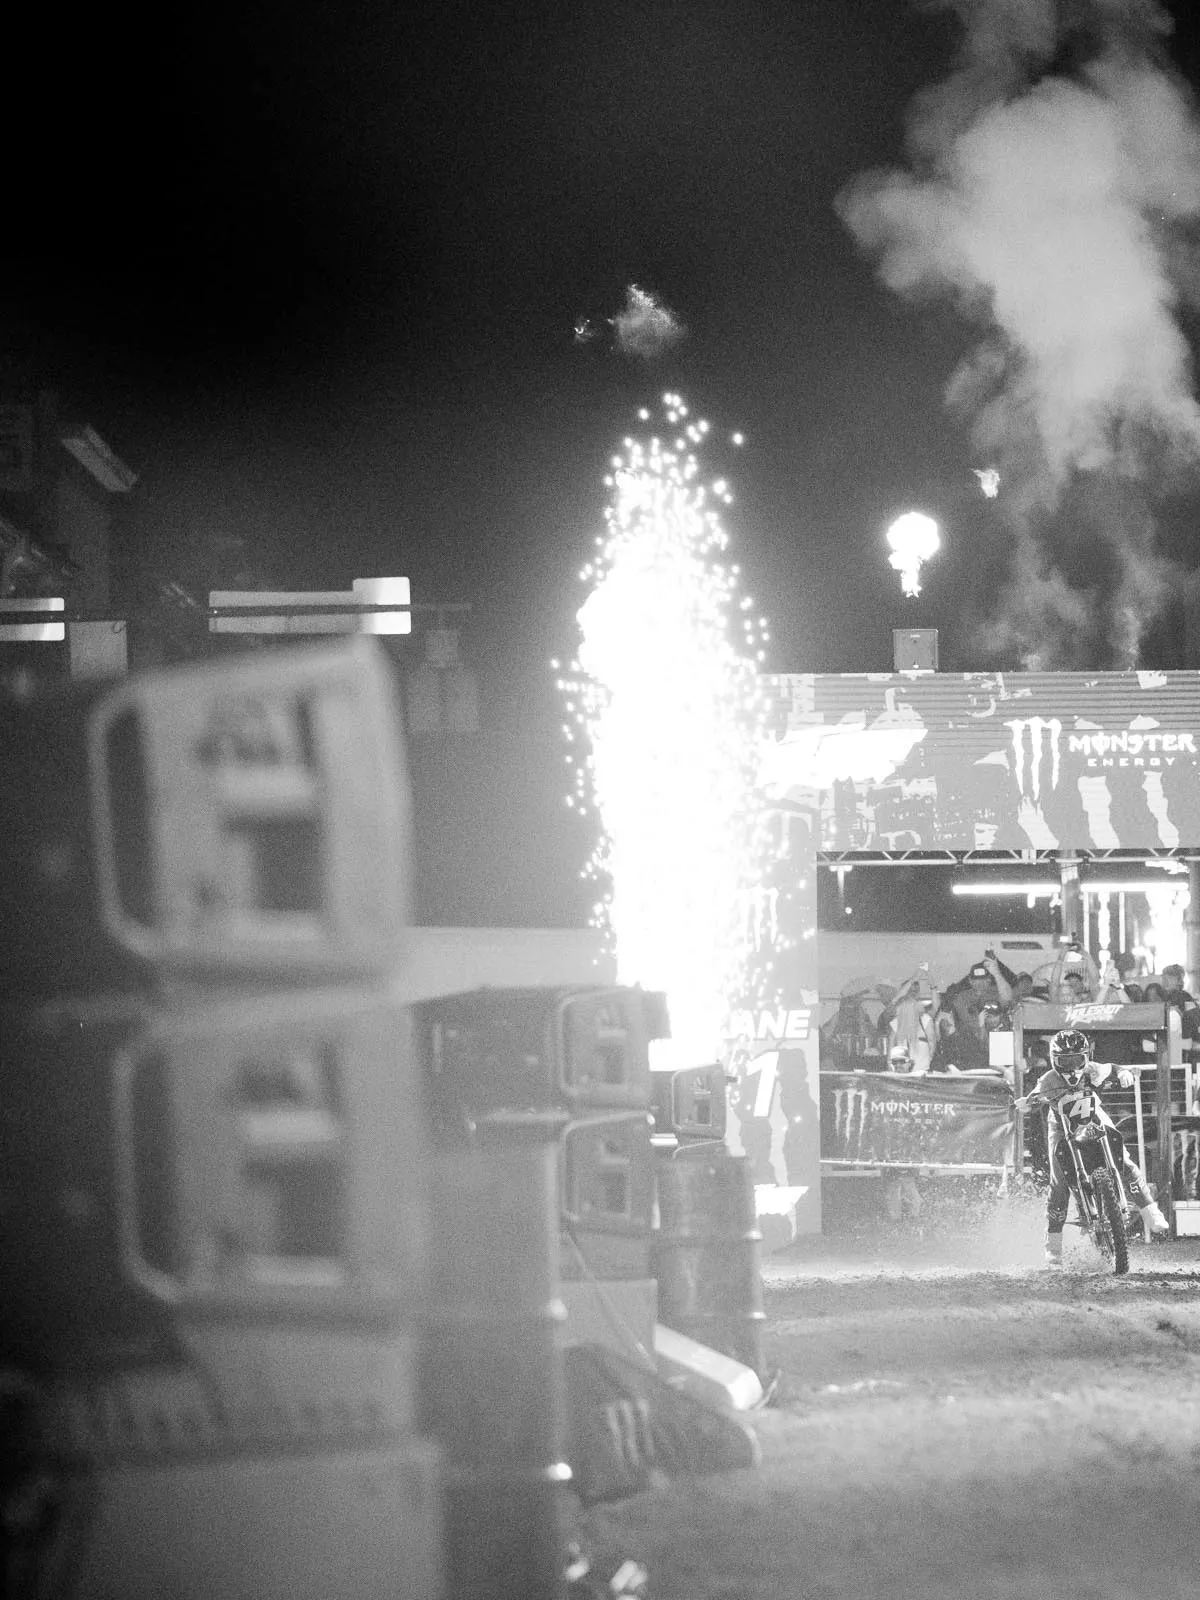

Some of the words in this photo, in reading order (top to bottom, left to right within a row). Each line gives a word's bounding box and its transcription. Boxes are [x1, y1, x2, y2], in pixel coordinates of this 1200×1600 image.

[1069, 731, 1198, 755] MONSTER
[1087, 757, 1176, 767] ENERGY
[729, 1009, 812, 1040] ANE
[746, 1051, 779, 1117] 1
[870, 1100, 956, 1116] MONSTER
[1069, 1097, 1094, 1119] 4
